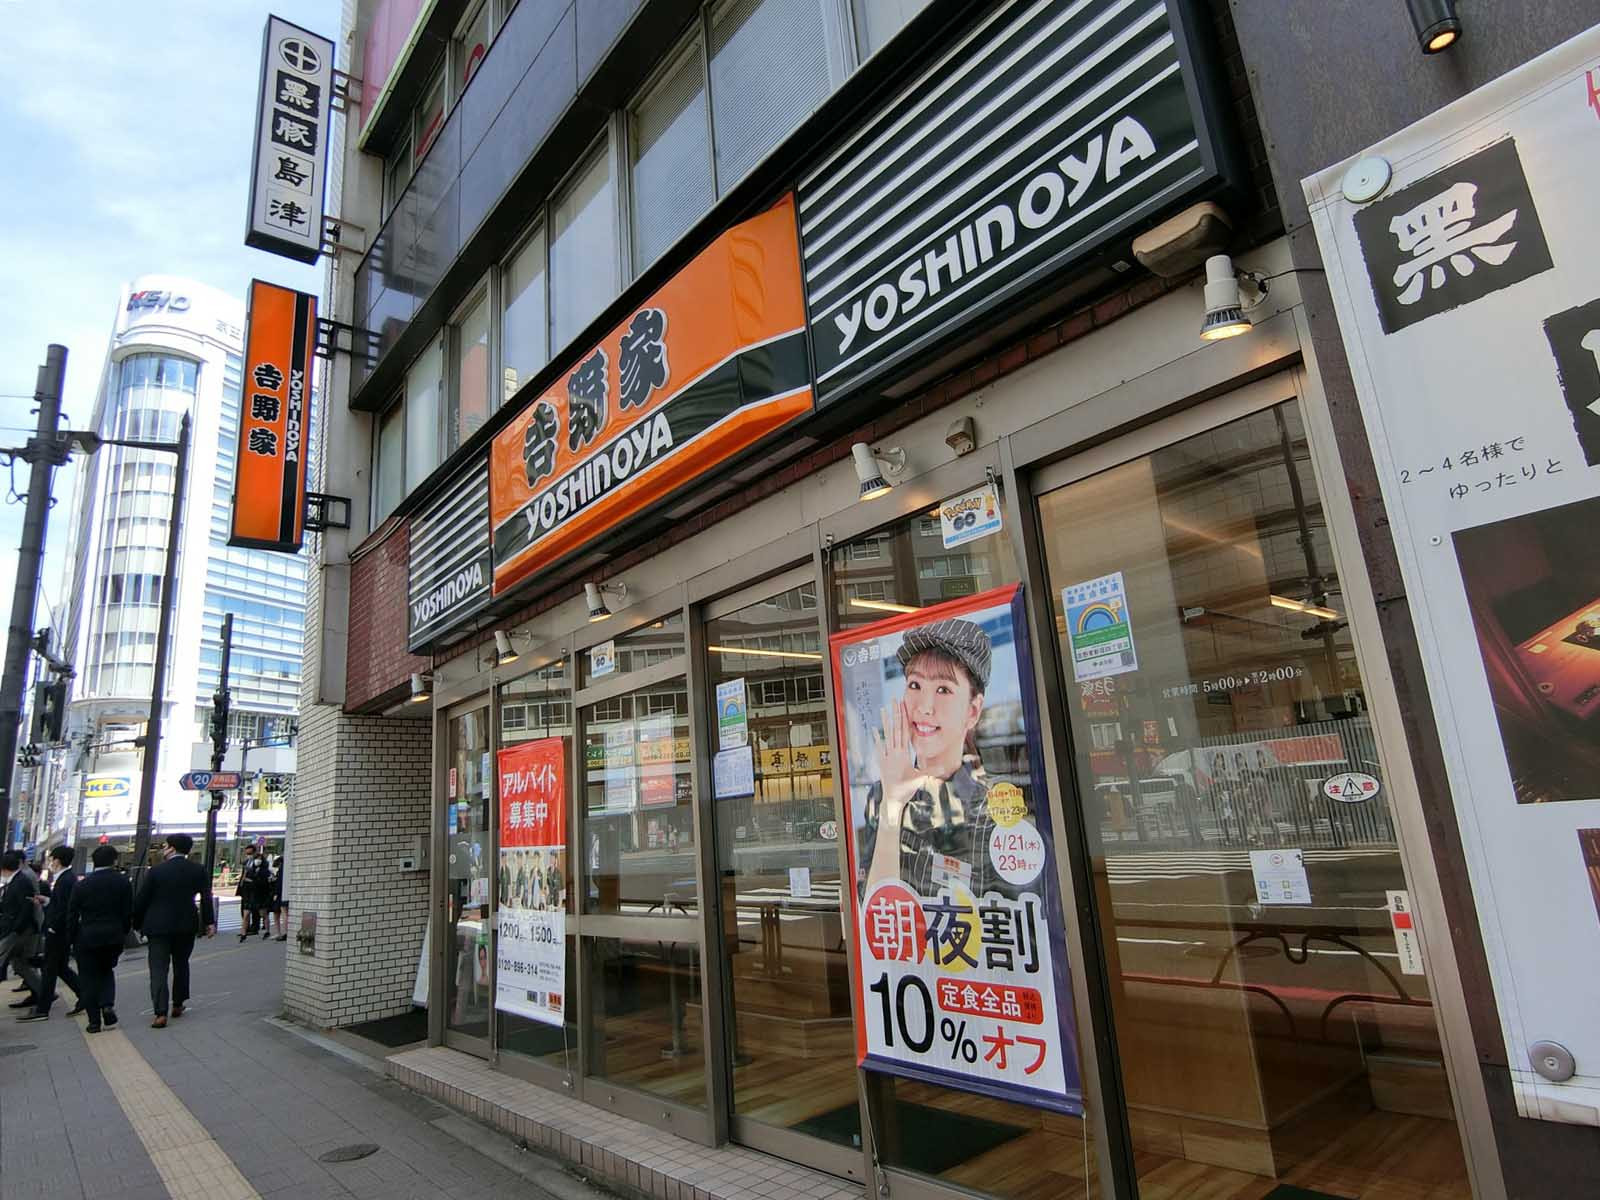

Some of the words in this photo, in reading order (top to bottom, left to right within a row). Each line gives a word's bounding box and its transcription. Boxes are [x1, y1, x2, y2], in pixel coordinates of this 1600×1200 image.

[834, 115, 1156, 355] YOSHINOYA
[249, 363, 284, 456] 吉野家
[286, 369, 304, 462] YOSHINOYA
[525, 411, 674, 541] YOSHINOYA
[1449, 458, 1564, 500] ゆったりと
[953, 512, 977, 531] GO
[414, 562, 483, 627] YOSHINOYA
[194, 775, 209, 785] 20
[502, 763, 557, 798] アルバイト
[509, 798, 548, 830] 募集中
[871, 895, 1040, 974] 朝夜割
[941, 982, 1022, 1018] 定食全品
